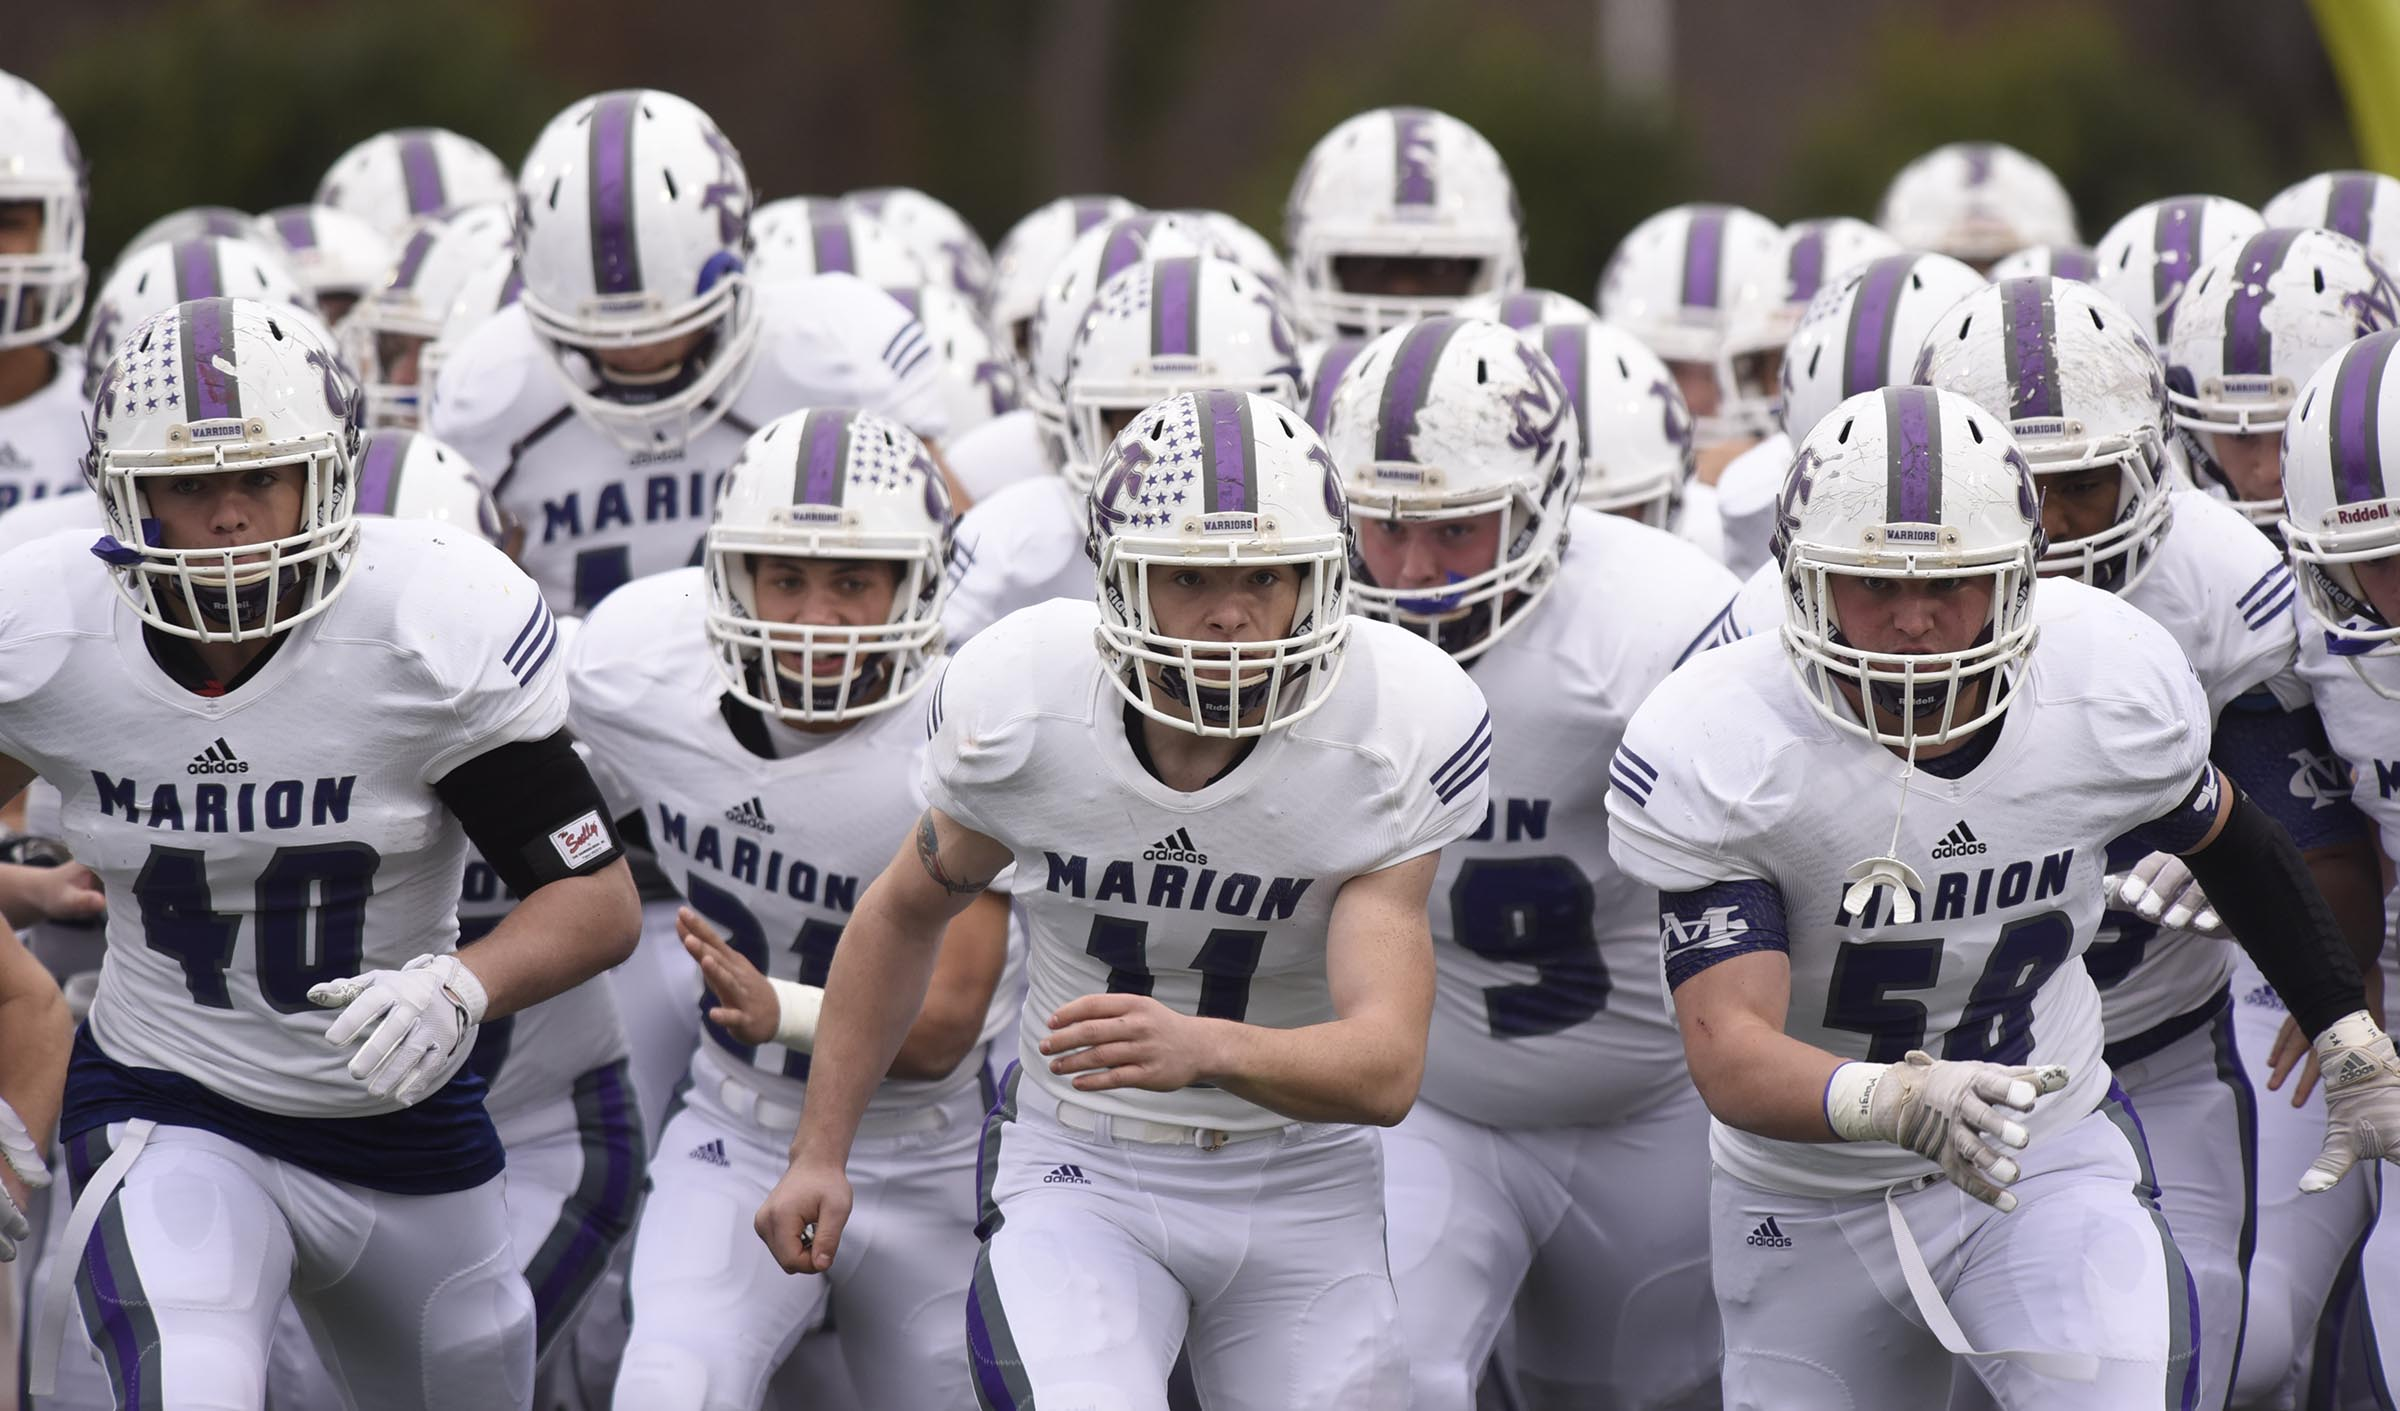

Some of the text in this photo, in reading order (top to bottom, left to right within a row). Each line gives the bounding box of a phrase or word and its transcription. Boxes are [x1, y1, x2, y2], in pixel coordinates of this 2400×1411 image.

[192, 425, 241, 438] WARRIORS
[2014, 423, 2062, 435] WARRIORS
[2338, 503, 2389, 525] Riddell
[1203, 519, 1253, 531] WARRIORS
[1887, 529, 1936, 541] WARRIORS
[187, 760, 249, 775] adidas
[91, 769, 358, 833] MARION
[724, 810, 775, 835] adidas
[659, 800, 860, 914] MARION
[1143, 848, 1208, 866] adidas
[1931, 840, 1988, 860] adidas
[1043, 850, 1316, 921] MARION
[131, 840, 382, 1015] 40
[1086, 913, 1268, 1024] 11
[1822, 909, 2075, 1066] 58
[2339, 1063, 2376, 1083] adidas
[1043, 1173, 1092, 1185] adidas
[1746, 1234, 1793, 1248] adidas
